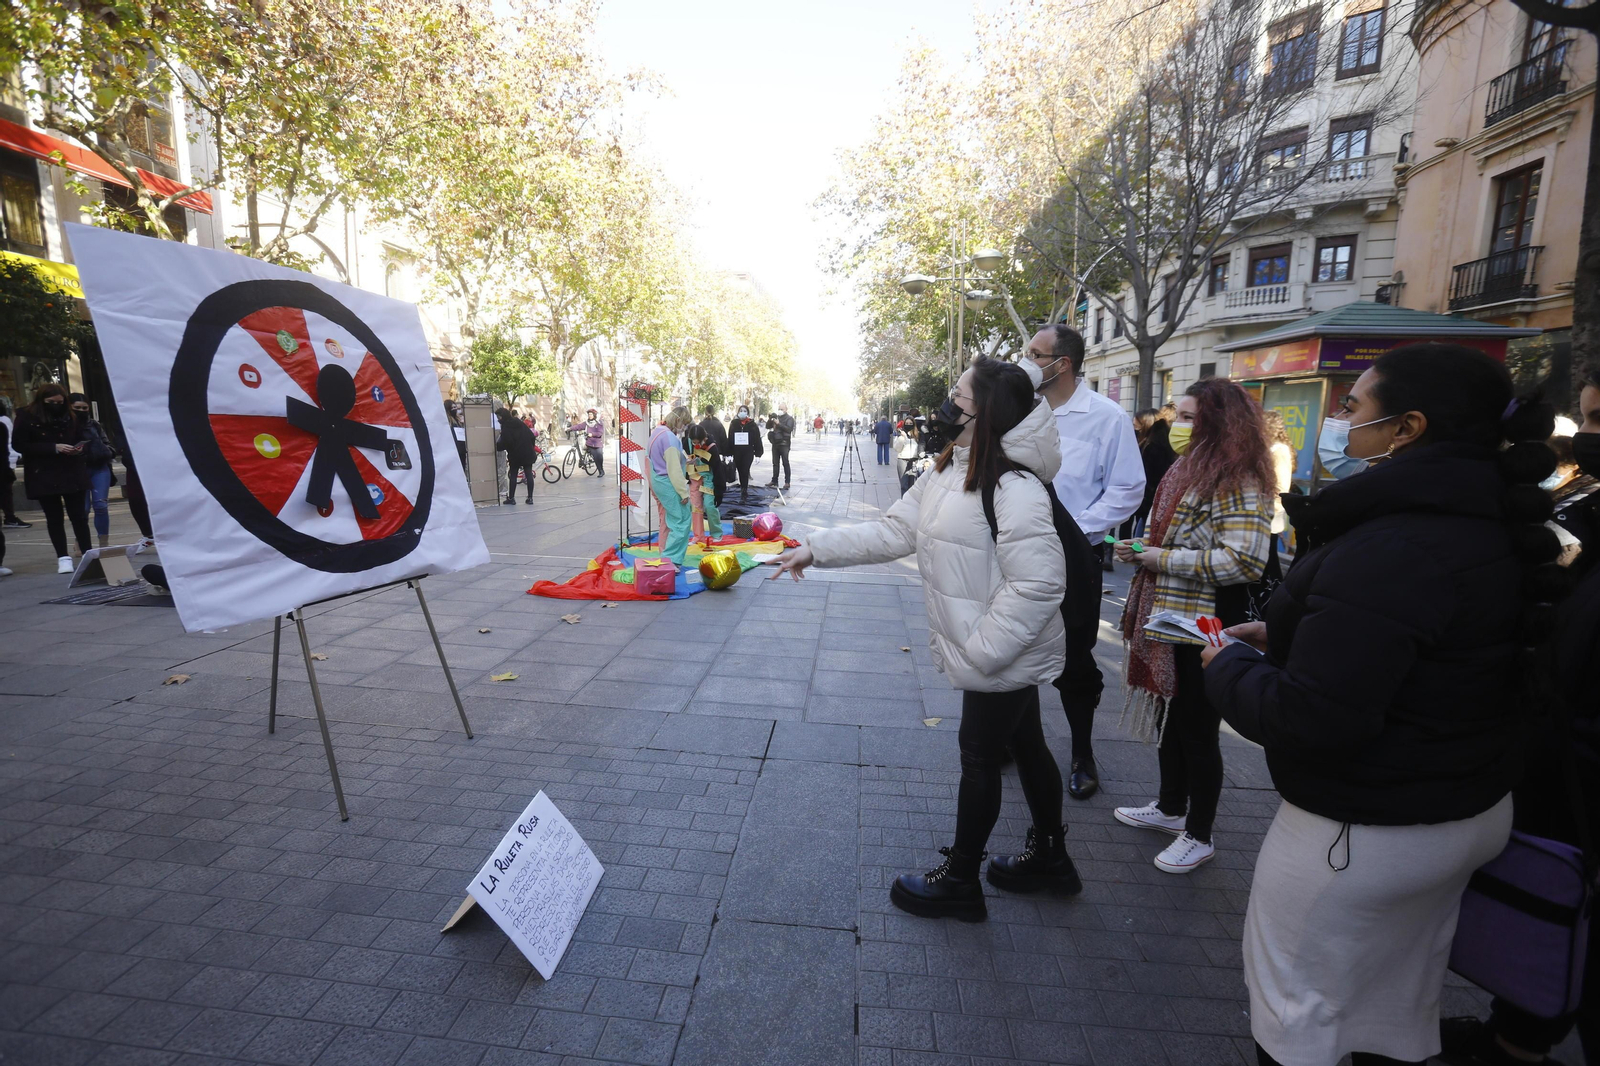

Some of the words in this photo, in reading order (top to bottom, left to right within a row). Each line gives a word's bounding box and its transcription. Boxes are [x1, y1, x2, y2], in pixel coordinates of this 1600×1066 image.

[539, 818, 558, 843] RULETA
[480, 874, 500, 894] LA
[494, 840, 523, 874] RULETA
[517, 815, 539, 839] RUSA
[529, 849, 538, 861] EN
[536, 842, 543, 852] LA
[504, 904, 517, 919] TE
[513, 857, 547, 906] REPRESENTA
[508, 860, 532, 894] PERSONA
[548, 877, 560, 896] LAS
[494, 898, 509, 912] LA
[512, 890, 541, 930] PERSONA
[538, 874, 549, 890] EN
[546, 864, 555, 876] LA
[529, 886, 565, 948] REPRESENTAN
[563, 870, 574, 887] LOS
[537, 935, 550, 956] QUE
